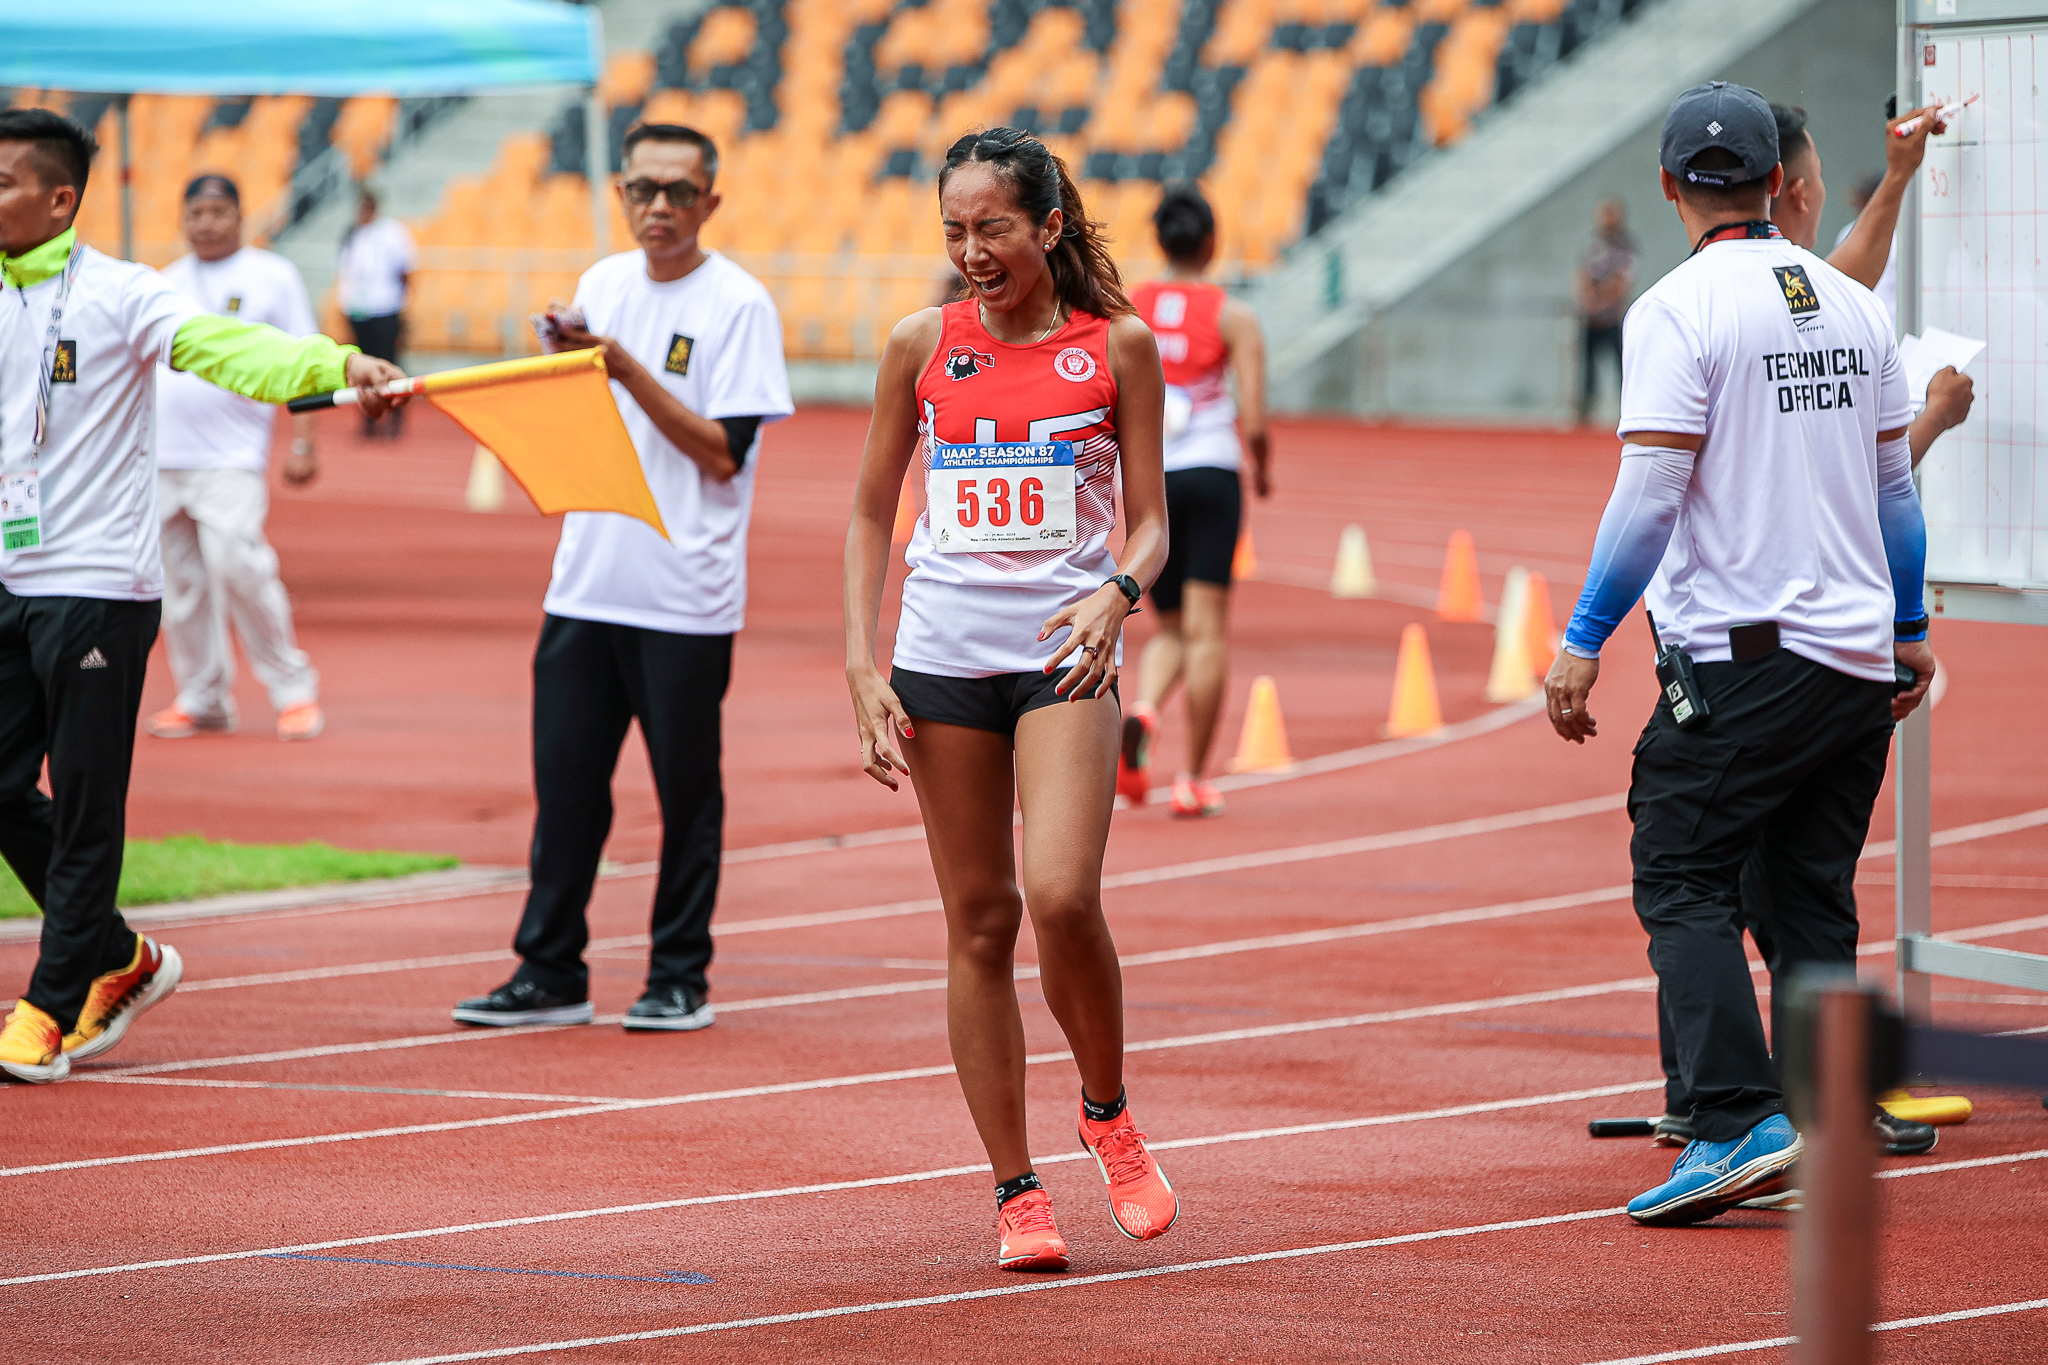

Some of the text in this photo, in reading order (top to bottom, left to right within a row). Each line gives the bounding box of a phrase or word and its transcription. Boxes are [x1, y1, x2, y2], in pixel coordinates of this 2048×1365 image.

[1762, 348, 1869, 381] TECHNICAL
[1778, 381, 1855, 413] OFFICIA
[942, 446, 1056, 459] UAAP SEASON 87
[943, 456, 1054, 467] ATHLETICS CHAMPIONSHIPS
[957, 477, 1044, 528] 536
